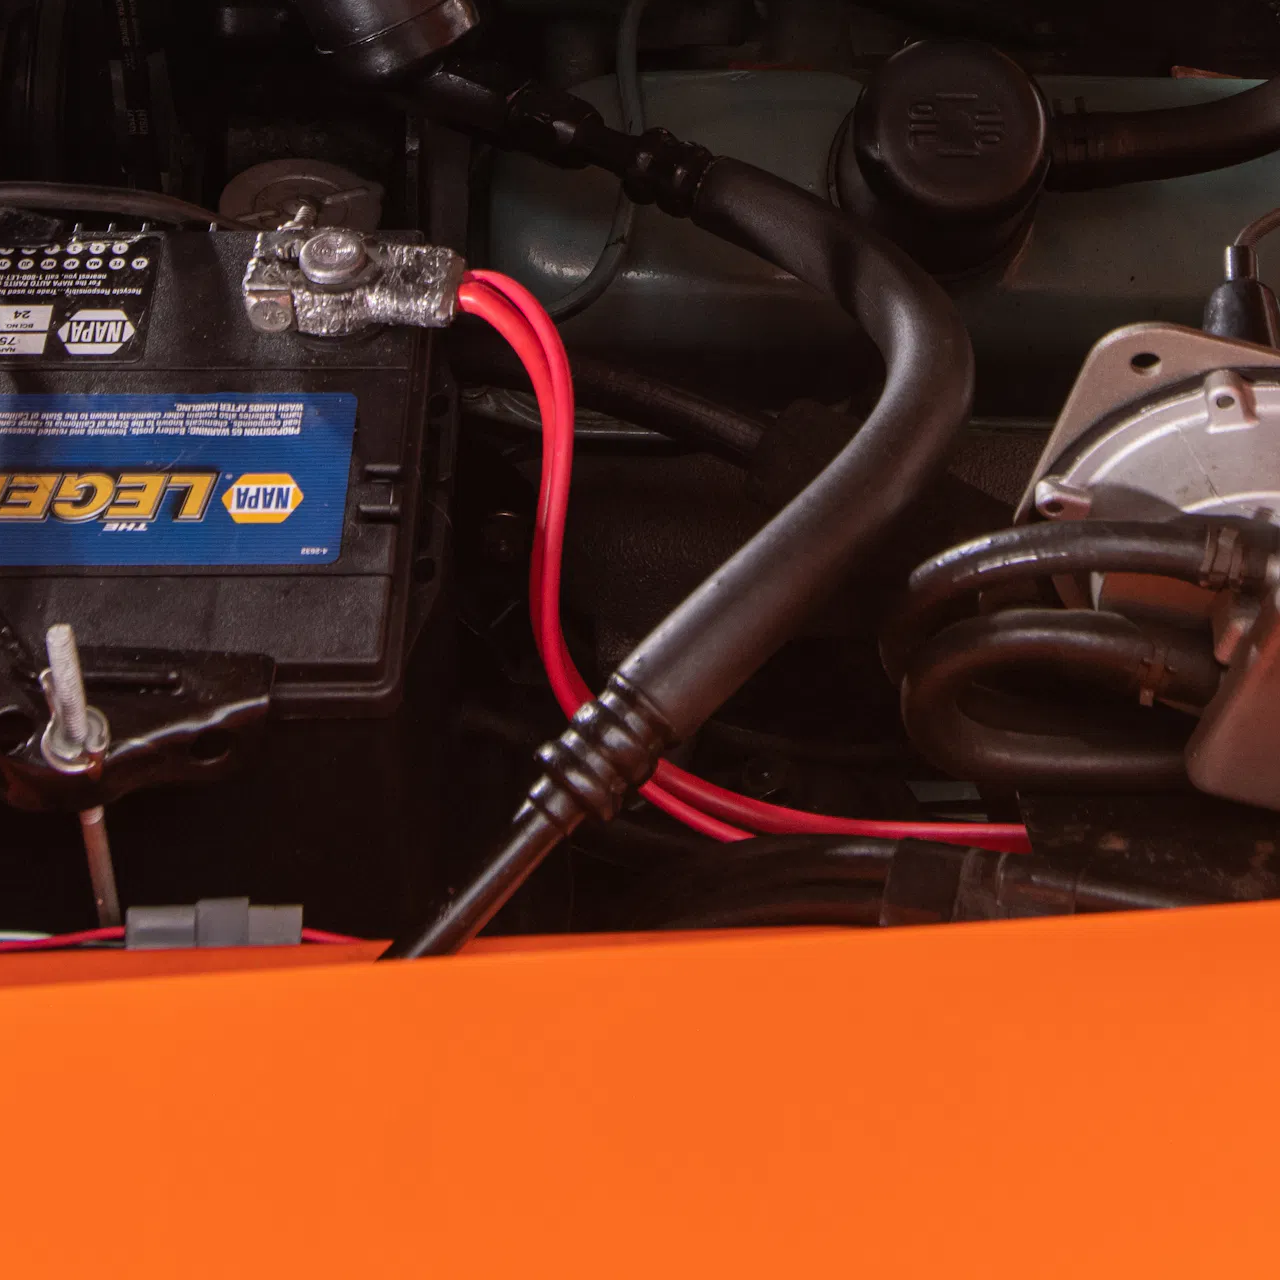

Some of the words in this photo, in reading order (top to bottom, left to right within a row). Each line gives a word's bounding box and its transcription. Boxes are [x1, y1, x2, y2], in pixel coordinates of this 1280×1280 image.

[12, 310, 31, 318] 24
[68, 320, 122, 342] NAPA
[234, 486, 290, 508] NAPA
[102, 522, 148, 531] THE
